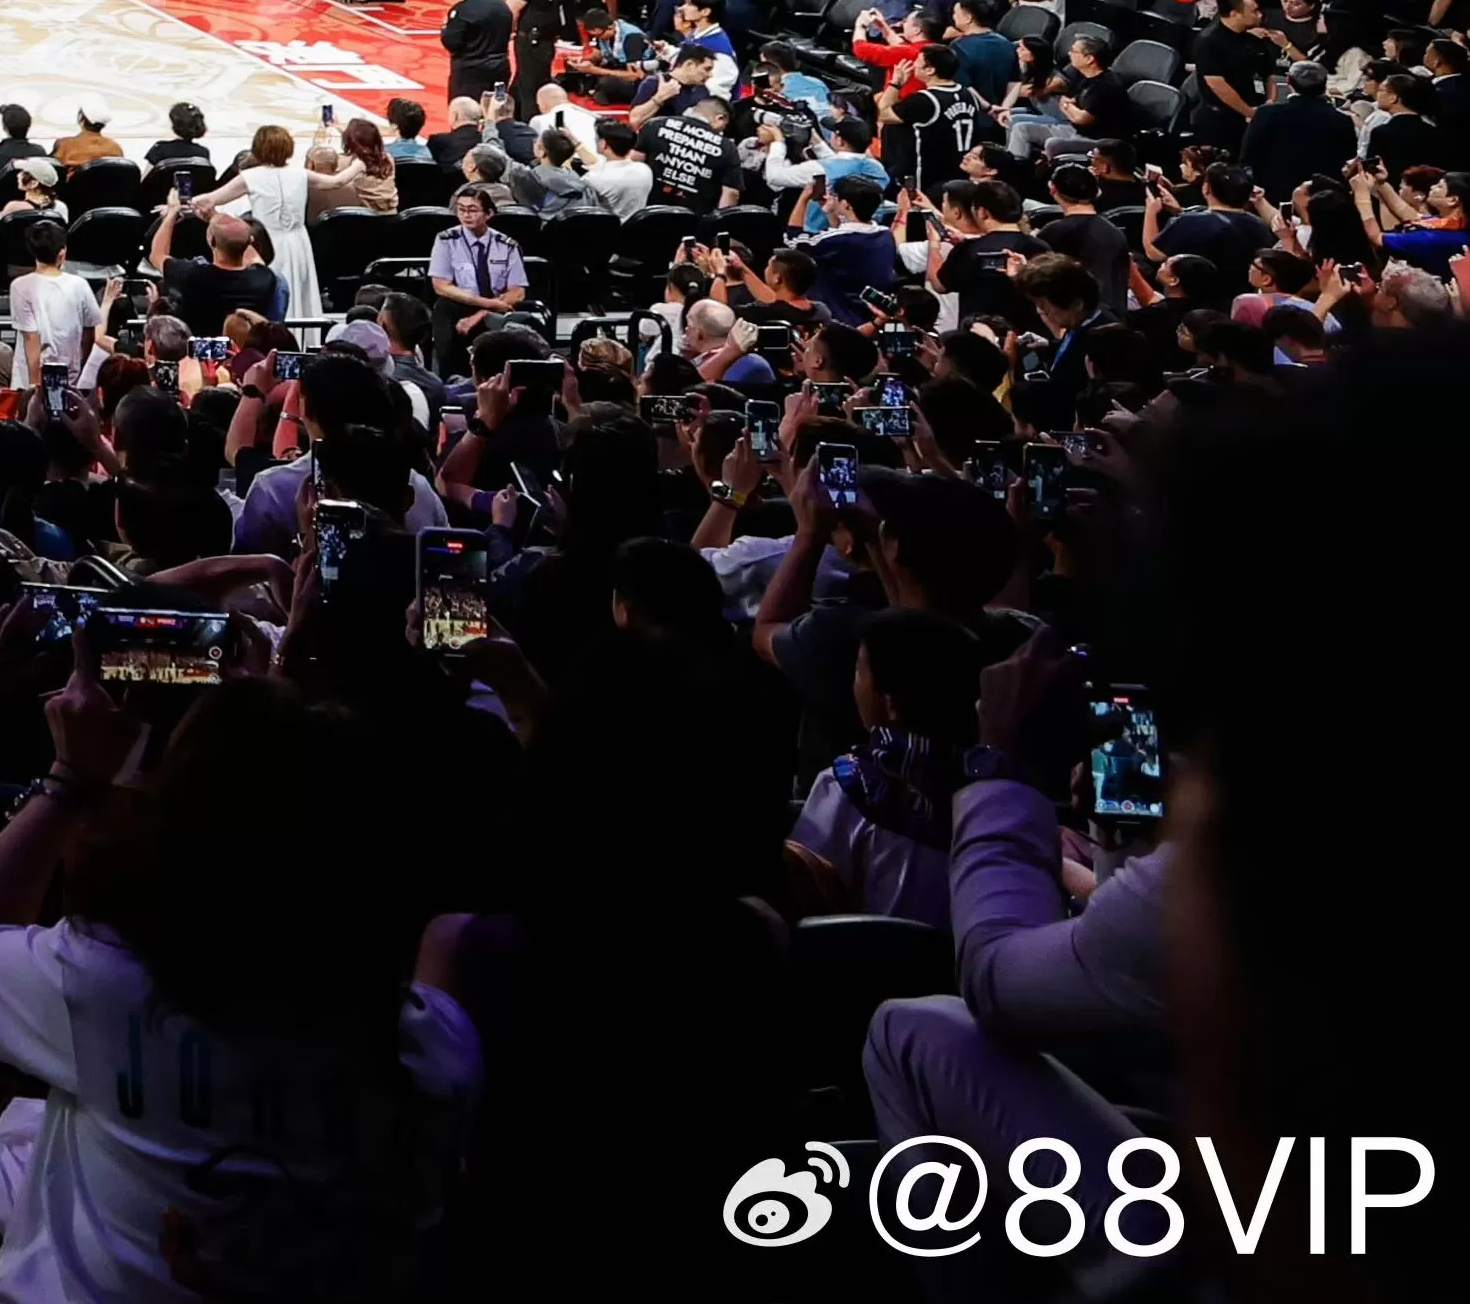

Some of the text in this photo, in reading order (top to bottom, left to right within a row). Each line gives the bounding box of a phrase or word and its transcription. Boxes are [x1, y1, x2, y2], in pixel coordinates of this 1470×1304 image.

[657, 127, 723, 158] PREPARED
[665, 118, 723, 145] BE MORE
[952, 119, 974, 152] 17
[654, 151, 713, 180] ANYONE
[668, 142, 707, 166] THAN
[663, 165, 697, 188] ELSE
